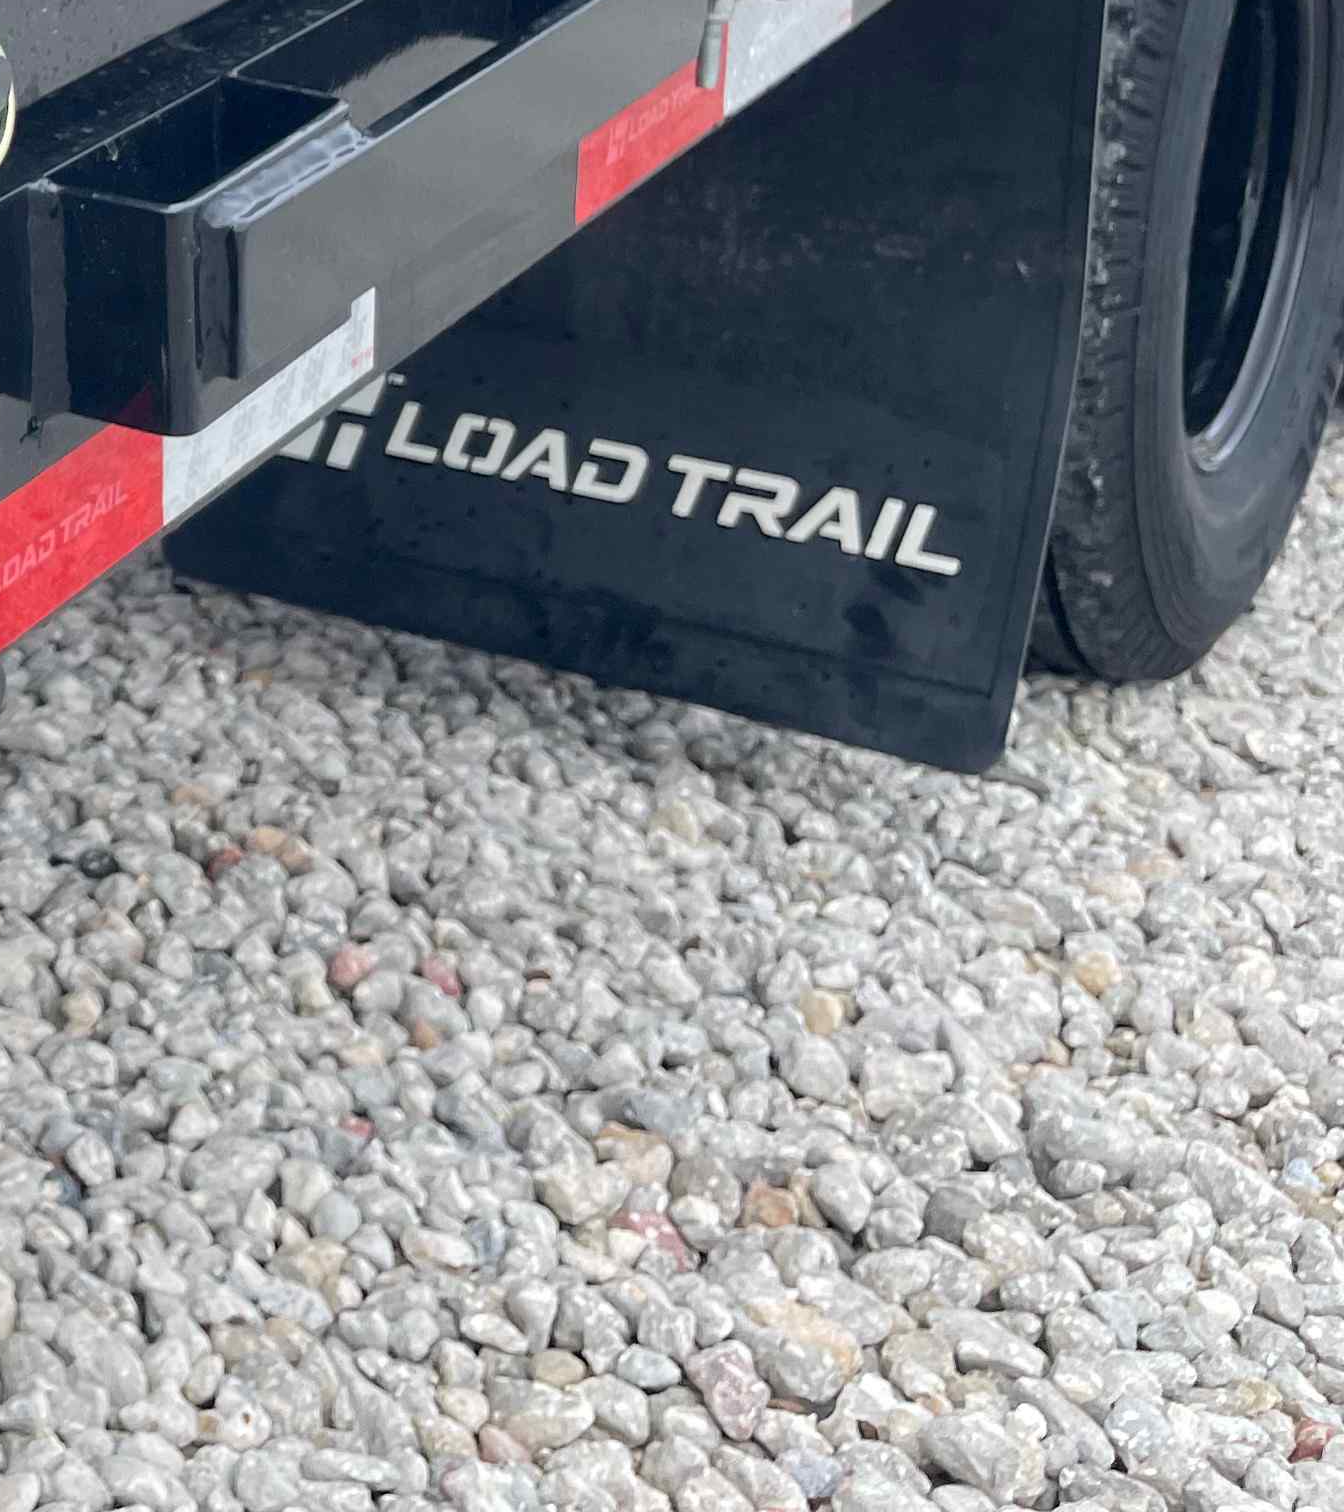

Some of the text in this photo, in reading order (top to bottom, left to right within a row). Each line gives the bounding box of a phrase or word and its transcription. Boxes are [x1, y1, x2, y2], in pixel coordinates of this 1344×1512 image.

[59, 480, 128, 543] TRAIL
[385, 400, 961, 577] LOAD TRAIL
